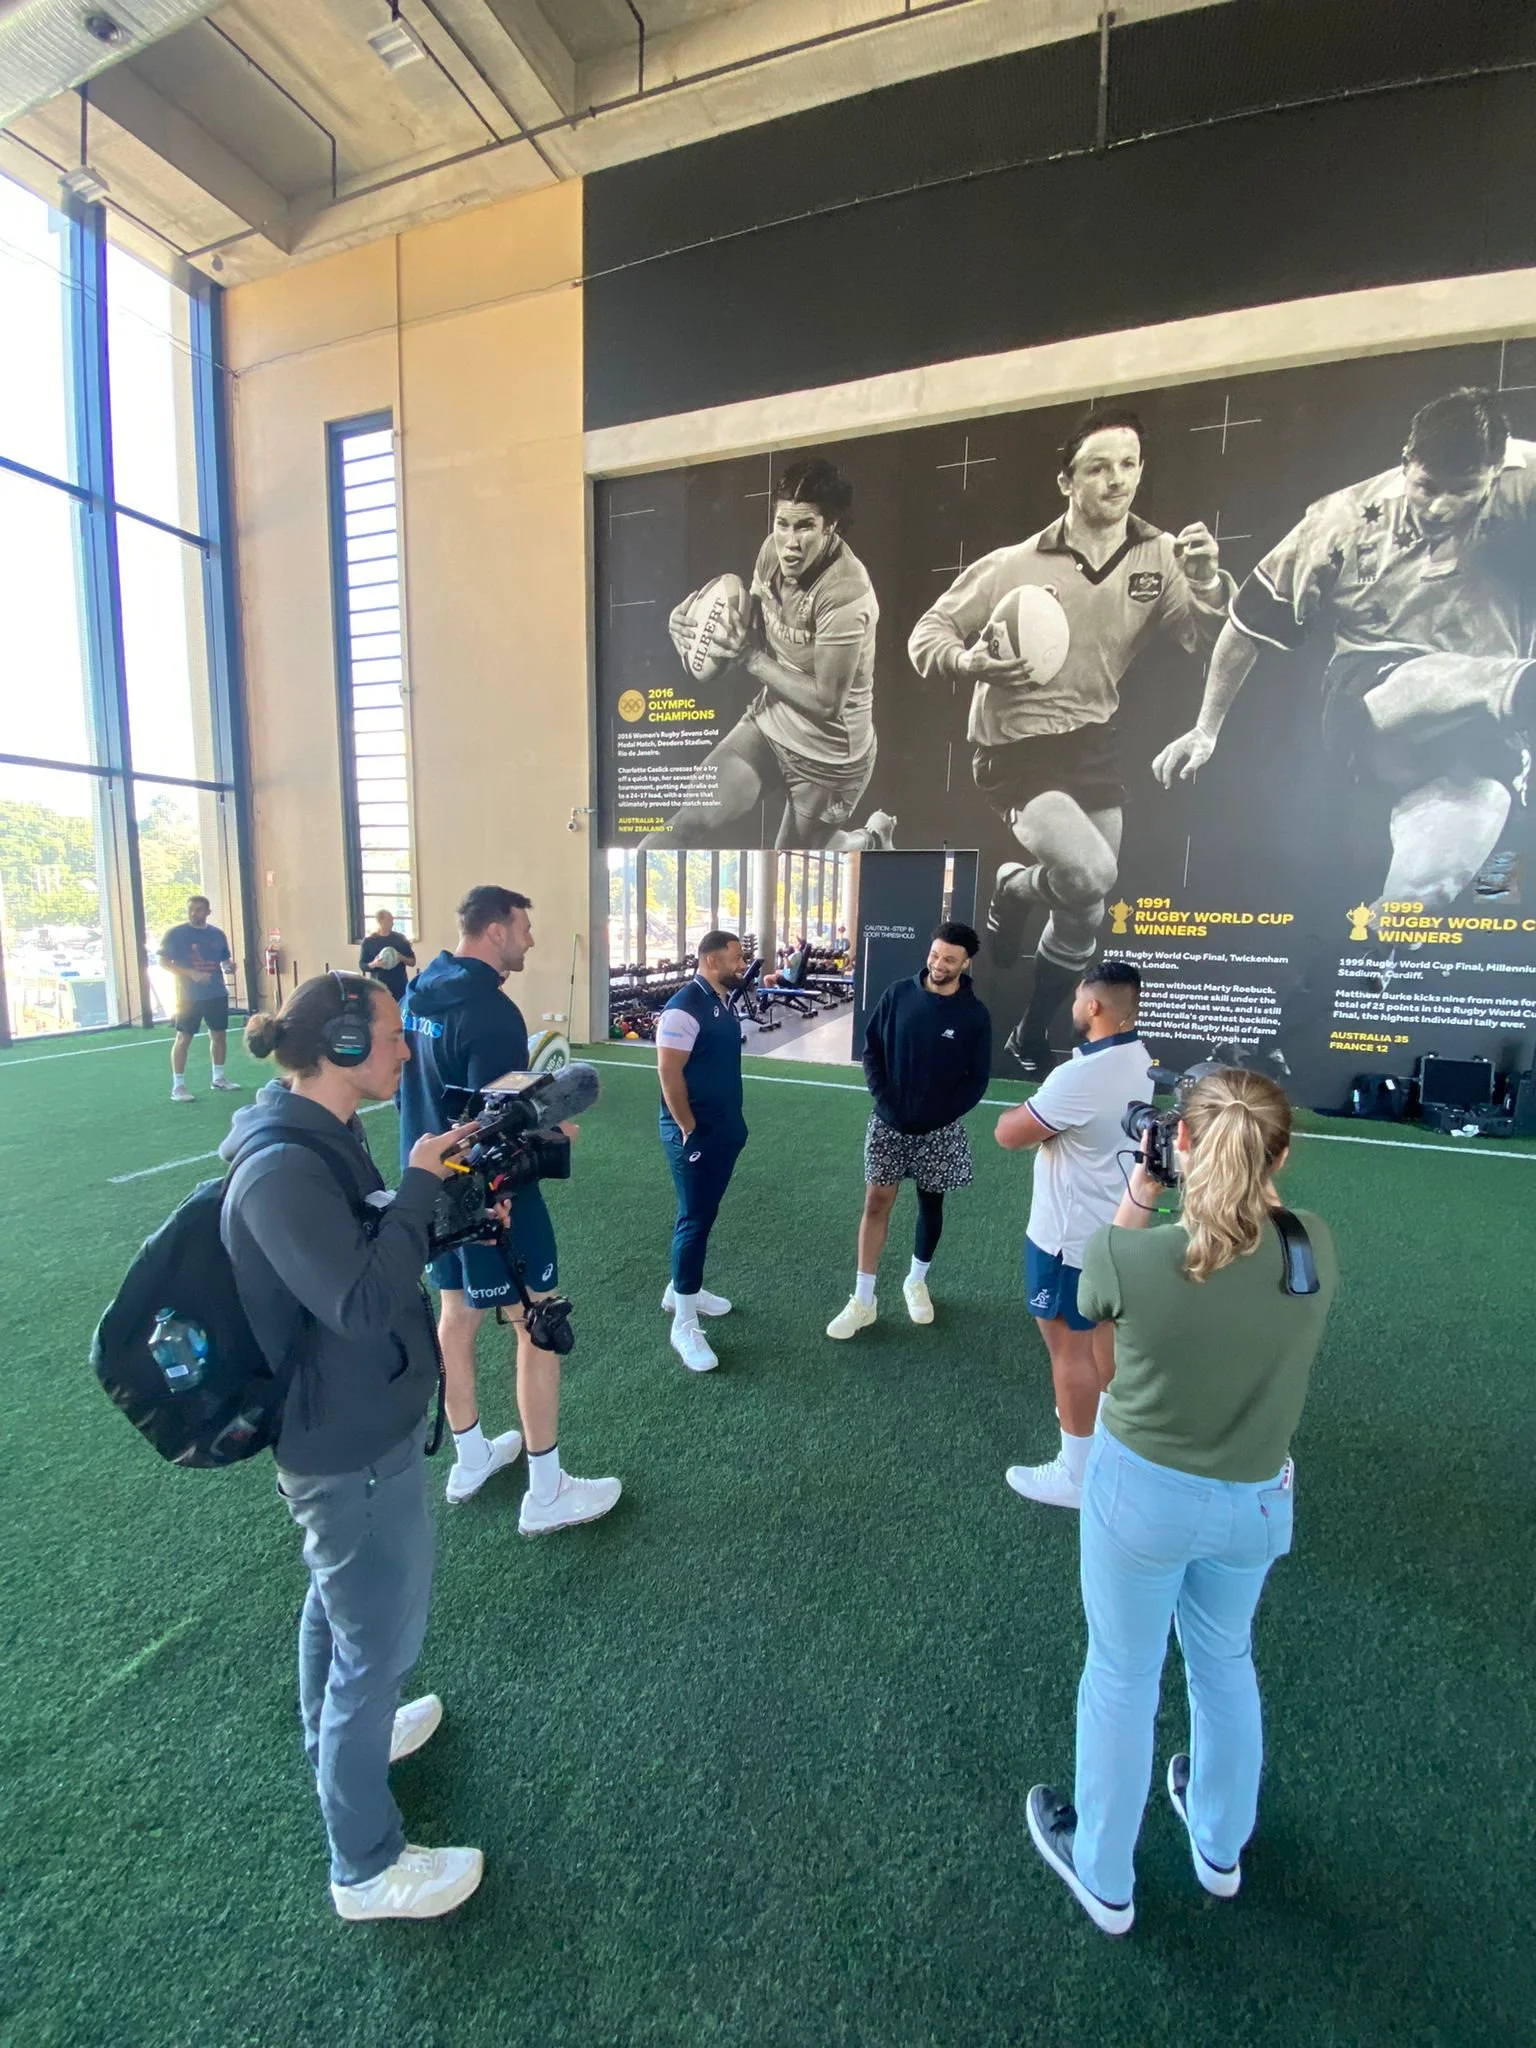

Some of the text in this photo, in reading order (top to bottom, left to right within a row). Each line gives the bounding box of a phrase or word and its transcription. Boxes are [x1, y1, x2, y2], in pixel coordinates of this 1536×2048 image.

[692, 597, 726, 672] GILBERT
[648, 688, 674, 698] 2016
[648, 699, 696, 710] OLYMPIC
[648, 710, 715, 722] CHAMPIONS
[1136, 898, 1171, 908] 1991
[1382, 902, 1424, 913] 1999
[1135, 911, 1294, 925] RUGBY WORLD CUP
[1379, 916, 1443, 928] RUGBY
[1448, 917, 1518, 930] WORLD
[1134, 925, 1208, 936] WINNERS
[1378, 930, 1463, 944] WINNERS
[1103, 950, 1288, 963] 1991 Rugby World Cup Final, Twickenham
[1142, 961, 1180, 969] London.
[1339, 958, 1365, 967] 1999
[1365, 959, 1398, 969] Rugby
[1399, 961, 1430, 969] World
[1432, 962, 1454, 972] Cup
[1455, 963, 1484, 972] Final,
[1337, 969, 1424, 980] Stadium, Cardiff.
[1166, 983, 1202, 991] without
[1203, 984, 1231, 993] Marty
[1232, 985, 1277, 994] Roebuck.
[1169, 994, 1209, 1002] supreme
[1210, 994, 1229, 1002] skill
[1230, 995, 1257, 1004] under
[1259, 996, 1276, 1004] the
[1335, 990, 1381, 999] Matthew
[1382, 991, 1412, 1001] Burke
[1413, 993, 1441, 1002] kicks
[1442, 995, 1465, 1003] nine
[1467, 996, 1493, 1005] from
[1495, 998, 1518, 1006] nine
[1138, 1001, 1186, 1011] completed
[1188, 1003, 1210, 1011] what
[1212, 1005, 1233, 1013] was,
[1263, 1007, 1282, 1015] still
[1334, 1000, 1359, 1009] total
[1361, 1001, 1372, 1009] of
[1372, 1002, 1385, 1010] 25
[1386, 1003, 1420, 1013] points
[1421, 1004, 1431, 1012] in
[1433, 1005, 1451, 1014] the
[1453, 1006, 1487, 1017] Rugby
[1489, 1008, 1521, 1017] World
[1149, 1010, 1197, 1020] Australia's
[1198, 1014, 1237, 1023] greatest
[1239, 1016, 1281, 1026] backline,
[1333, 1011, 1527, 1029] Final, the highest individual tally ever.
[1163, 1021, 1190, 1030] World
[1191, 1023, 1220, 1032] Rugby
[1221, 1023, 1240, 1033] Hall
[1240, 1025, 1252, 1033] of
[1252, 1026, 1277, 1035] fame
[1174, 1032, 1205, 1041] Horan,
[1206, 1034, 1240, 1044] Lynagh
[1241, 1036, 1259, 1044] and
[1330, 1031, 1409, 1043] AUSTRALIA 35
[1329, 1042, 1388, 1052] FRANCE 12
